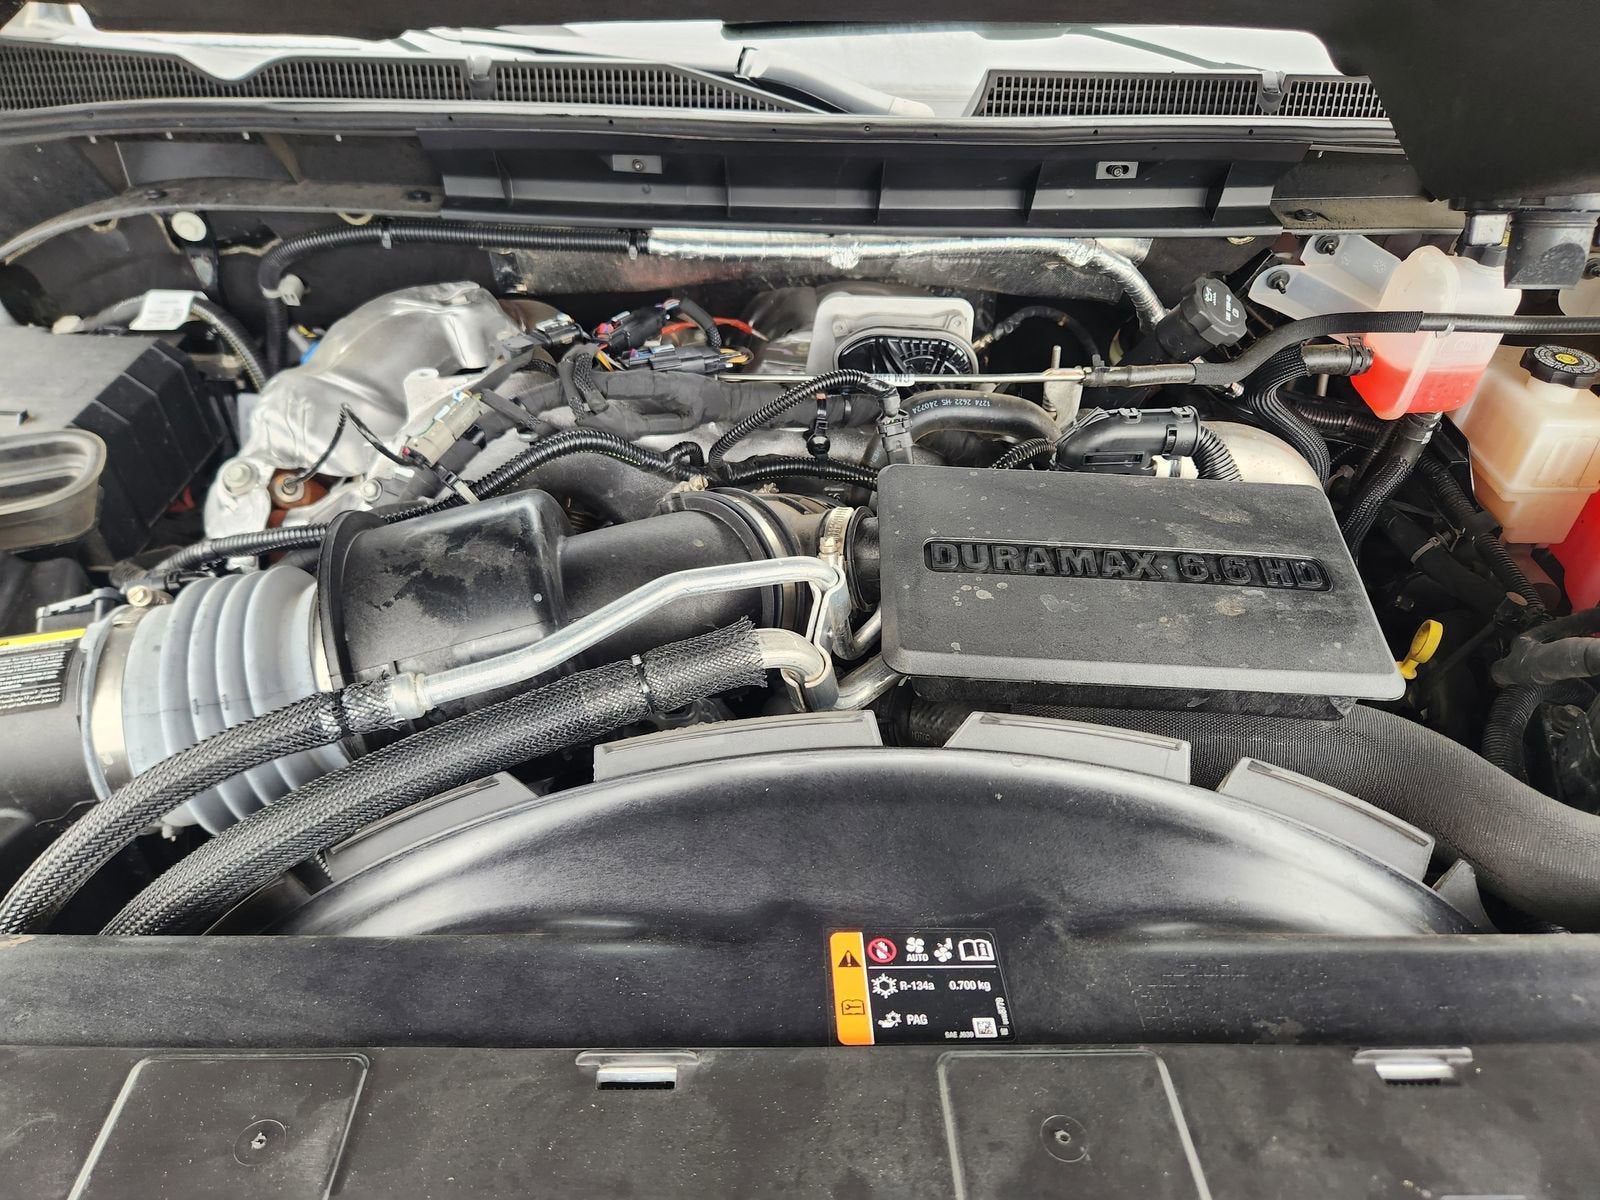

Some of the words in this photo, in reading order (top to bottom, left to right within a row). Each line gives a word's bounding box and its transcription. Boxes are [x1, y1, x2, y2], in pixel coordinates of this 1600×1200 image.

[930, 542, 1161, 579] DURAMAX
[1176, 552, 1252, 585] 6.6
[1261, 557, 1324, 588] HD
[906, 953, 929, 962] AUTO
[900, 980, 935, 991] R-134a
[949, 980, 977, 991] 0.700
[978, 980, 991, 992] kg
[906, 1014, 928, 1025] PAG
